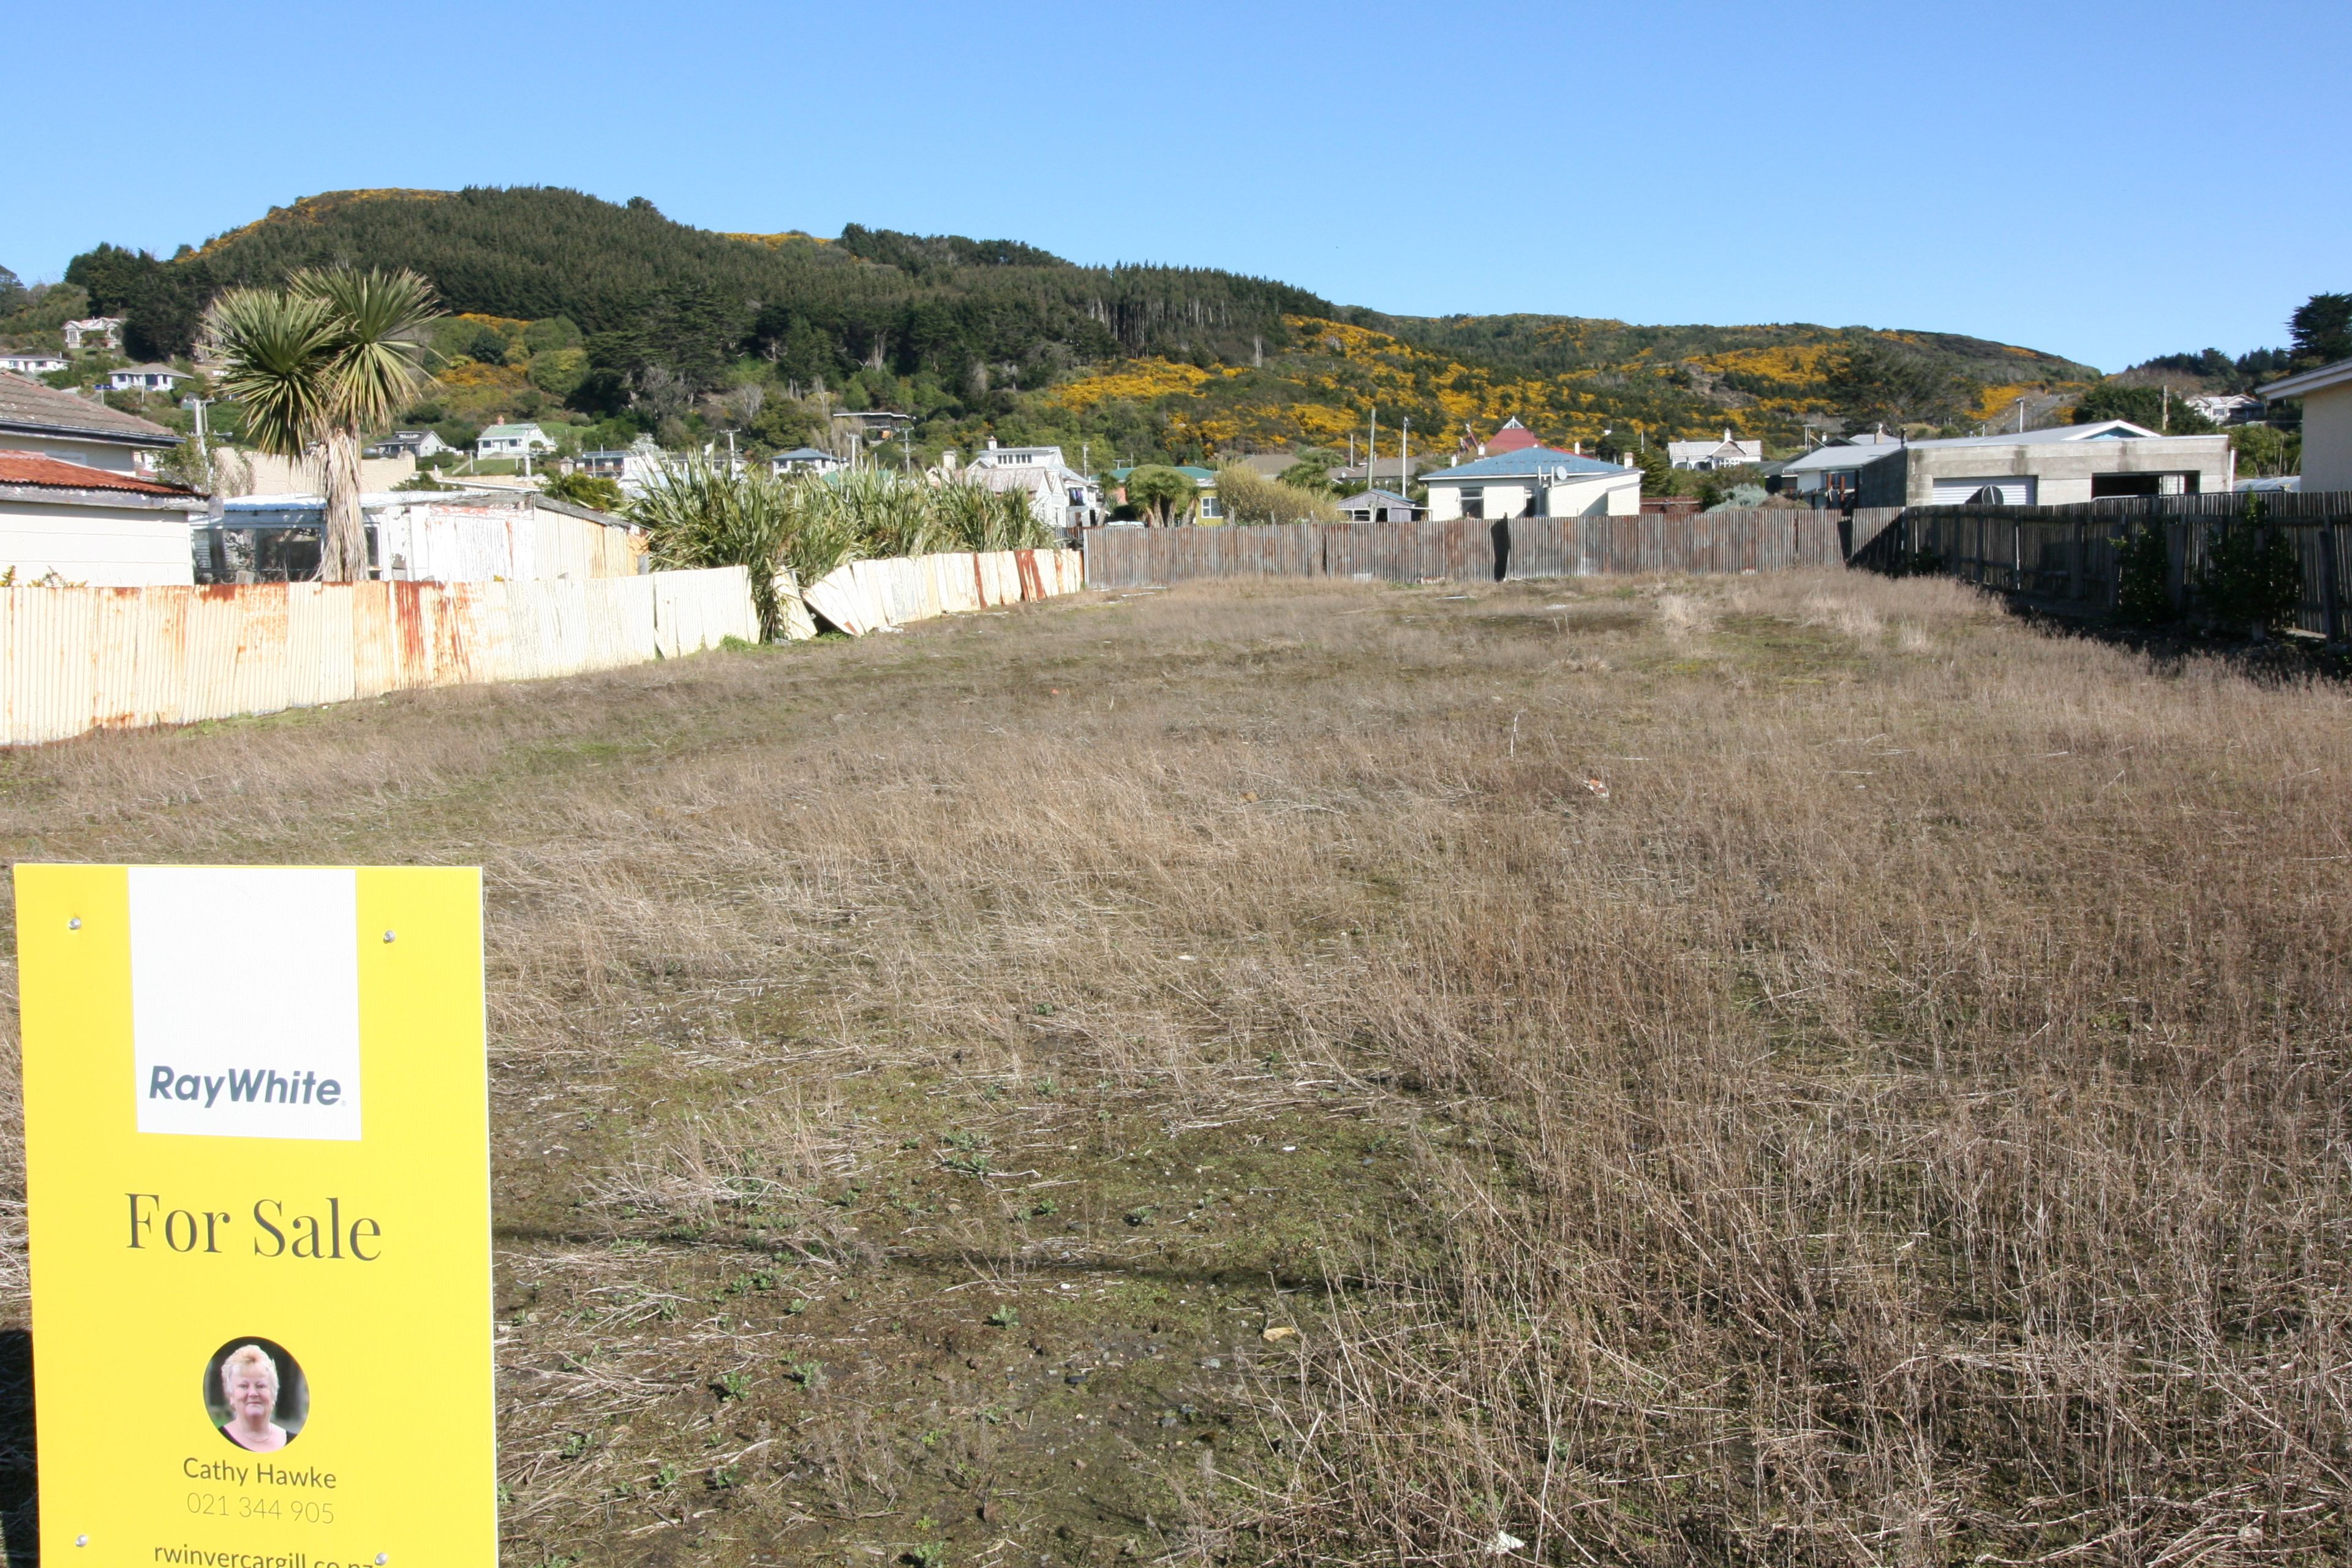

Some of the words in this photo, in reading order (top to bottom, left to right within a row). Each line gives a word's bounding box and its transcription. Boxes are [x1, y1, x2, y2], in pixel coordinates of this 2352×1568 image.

[149, 1065, 341, 1109] RayWhite
[124, 1193, 230, 1253] For
[253, 1197, 381, 1262] Sale
[183, 1457, 249, 1487] Cathy
[257, 1463, 336, 1489] Hawke
[187, 1492, 230, 1516] 021
[239, 1496, 282, 1520] 344
[290, 1501, 334, 1524] 905
[154, 1544, 373, 1568] rwinvercargill
